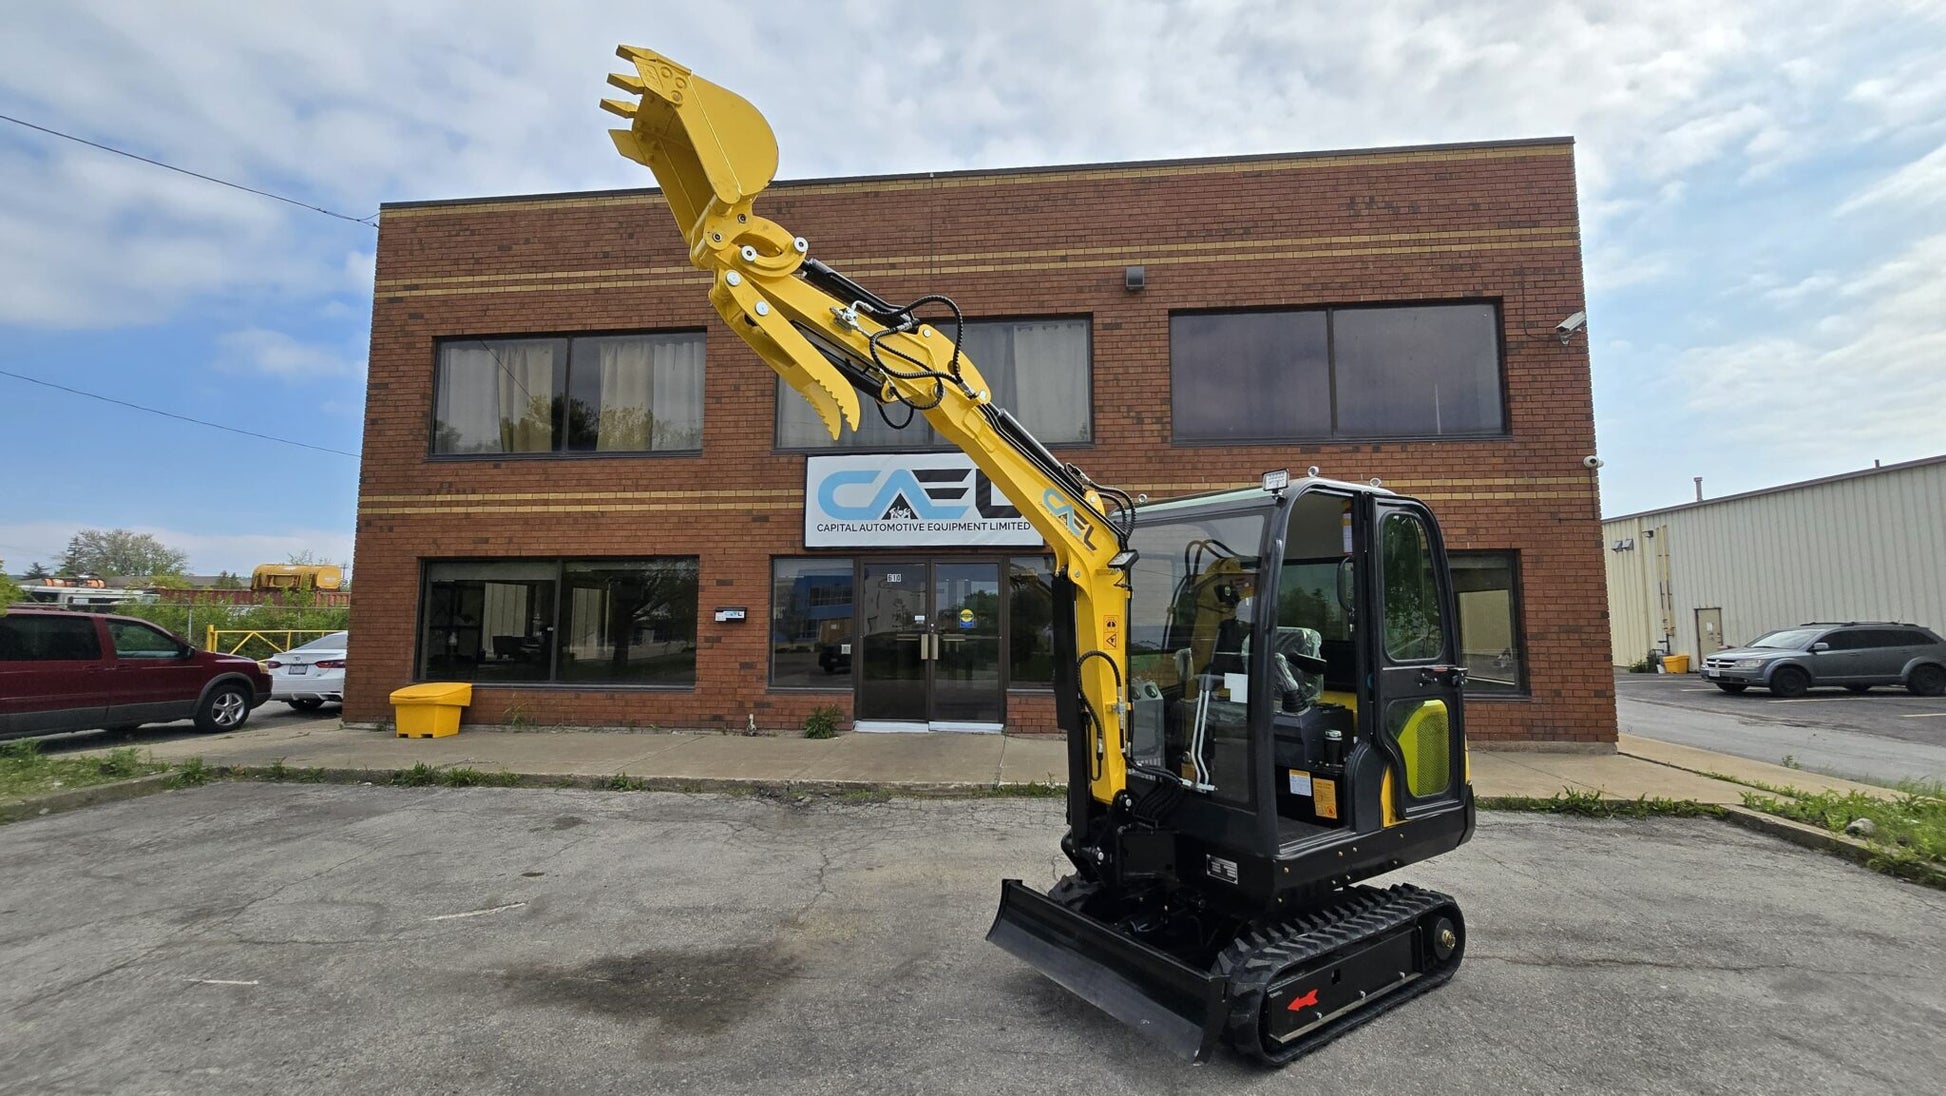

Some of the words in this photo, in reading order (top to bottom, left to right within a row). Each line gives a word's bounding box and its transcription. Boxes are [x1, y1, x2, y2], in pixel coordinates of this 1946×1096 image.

[818, 468, 1023, 520] CAEL
[1043, 487, 1097, 551] CAEL
[817, 523, 857, 532] CAPITAL
[859, 523, 925, 532] AUTOMOTIVE
[928, 522, 987, 532] EQUIPMENT
[990, 522, 1031, 531] LIMITED
